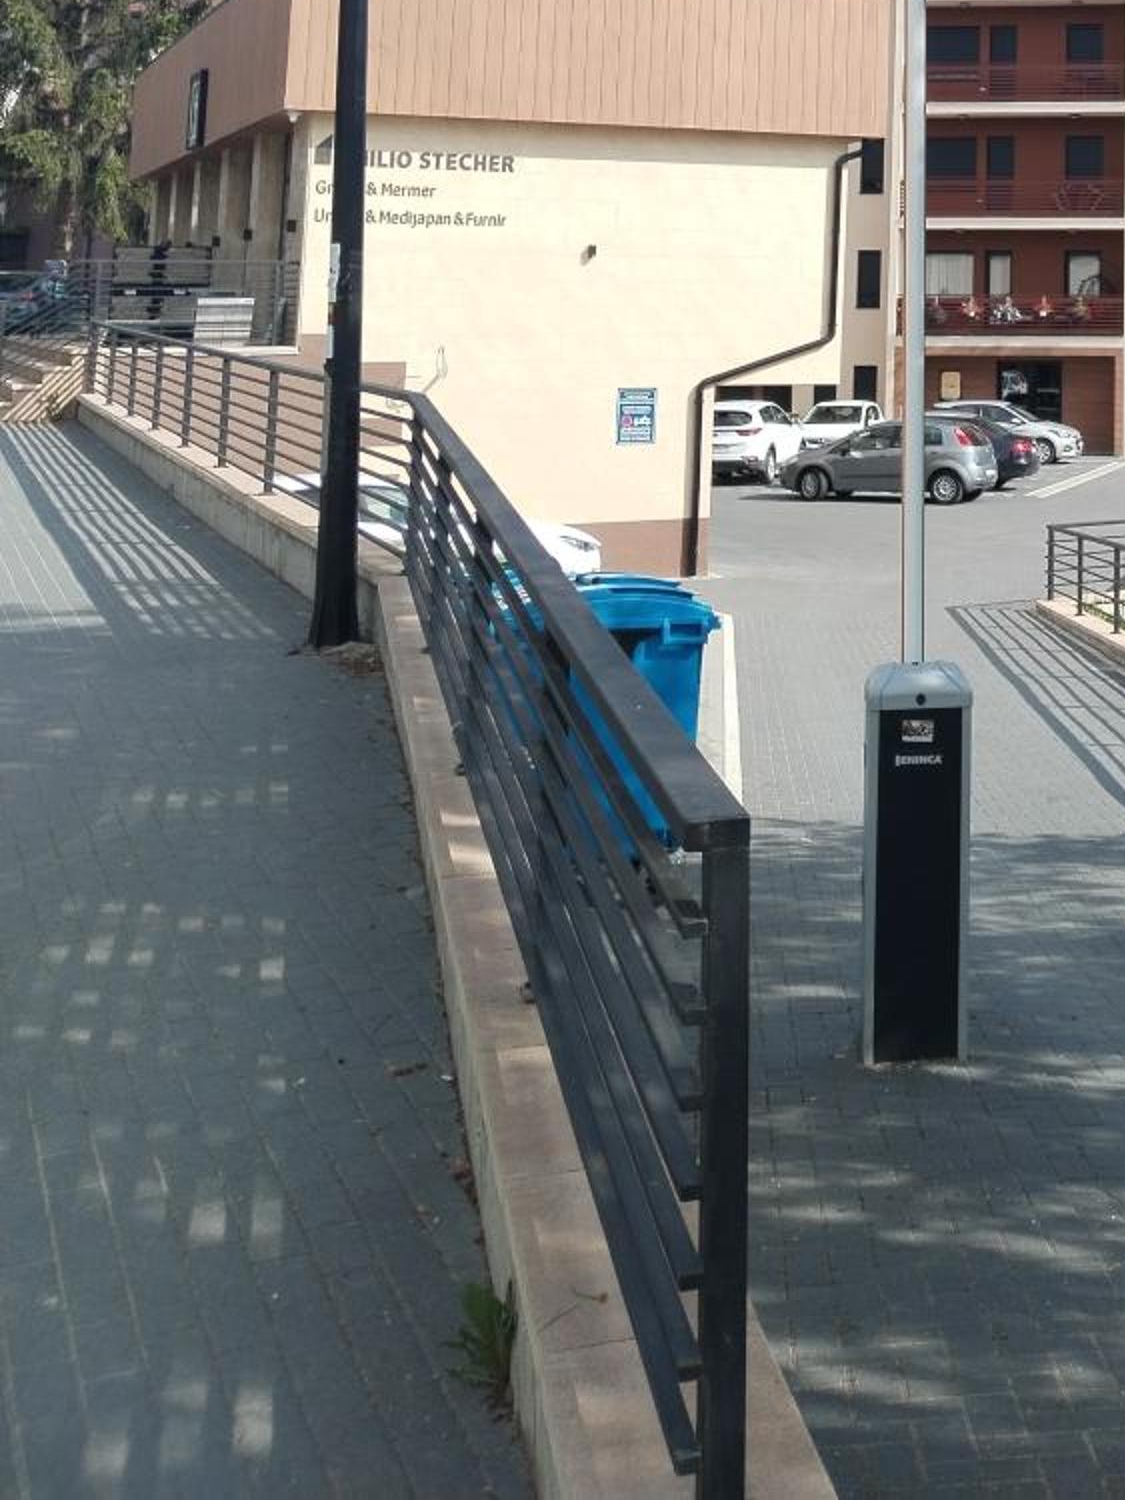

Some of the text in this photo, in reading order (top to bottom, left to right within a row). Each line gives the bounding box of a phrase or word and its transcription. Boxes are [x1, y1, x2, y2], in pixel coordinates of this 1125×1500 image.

[364, 150, 514, 173] ILIO STECHER
[367, 181, 436, 197] & Mermer
[365, 209, 376, 224] &
[379, 209, 451, 229] Medijapan
[453, 211, 464, 226] &
